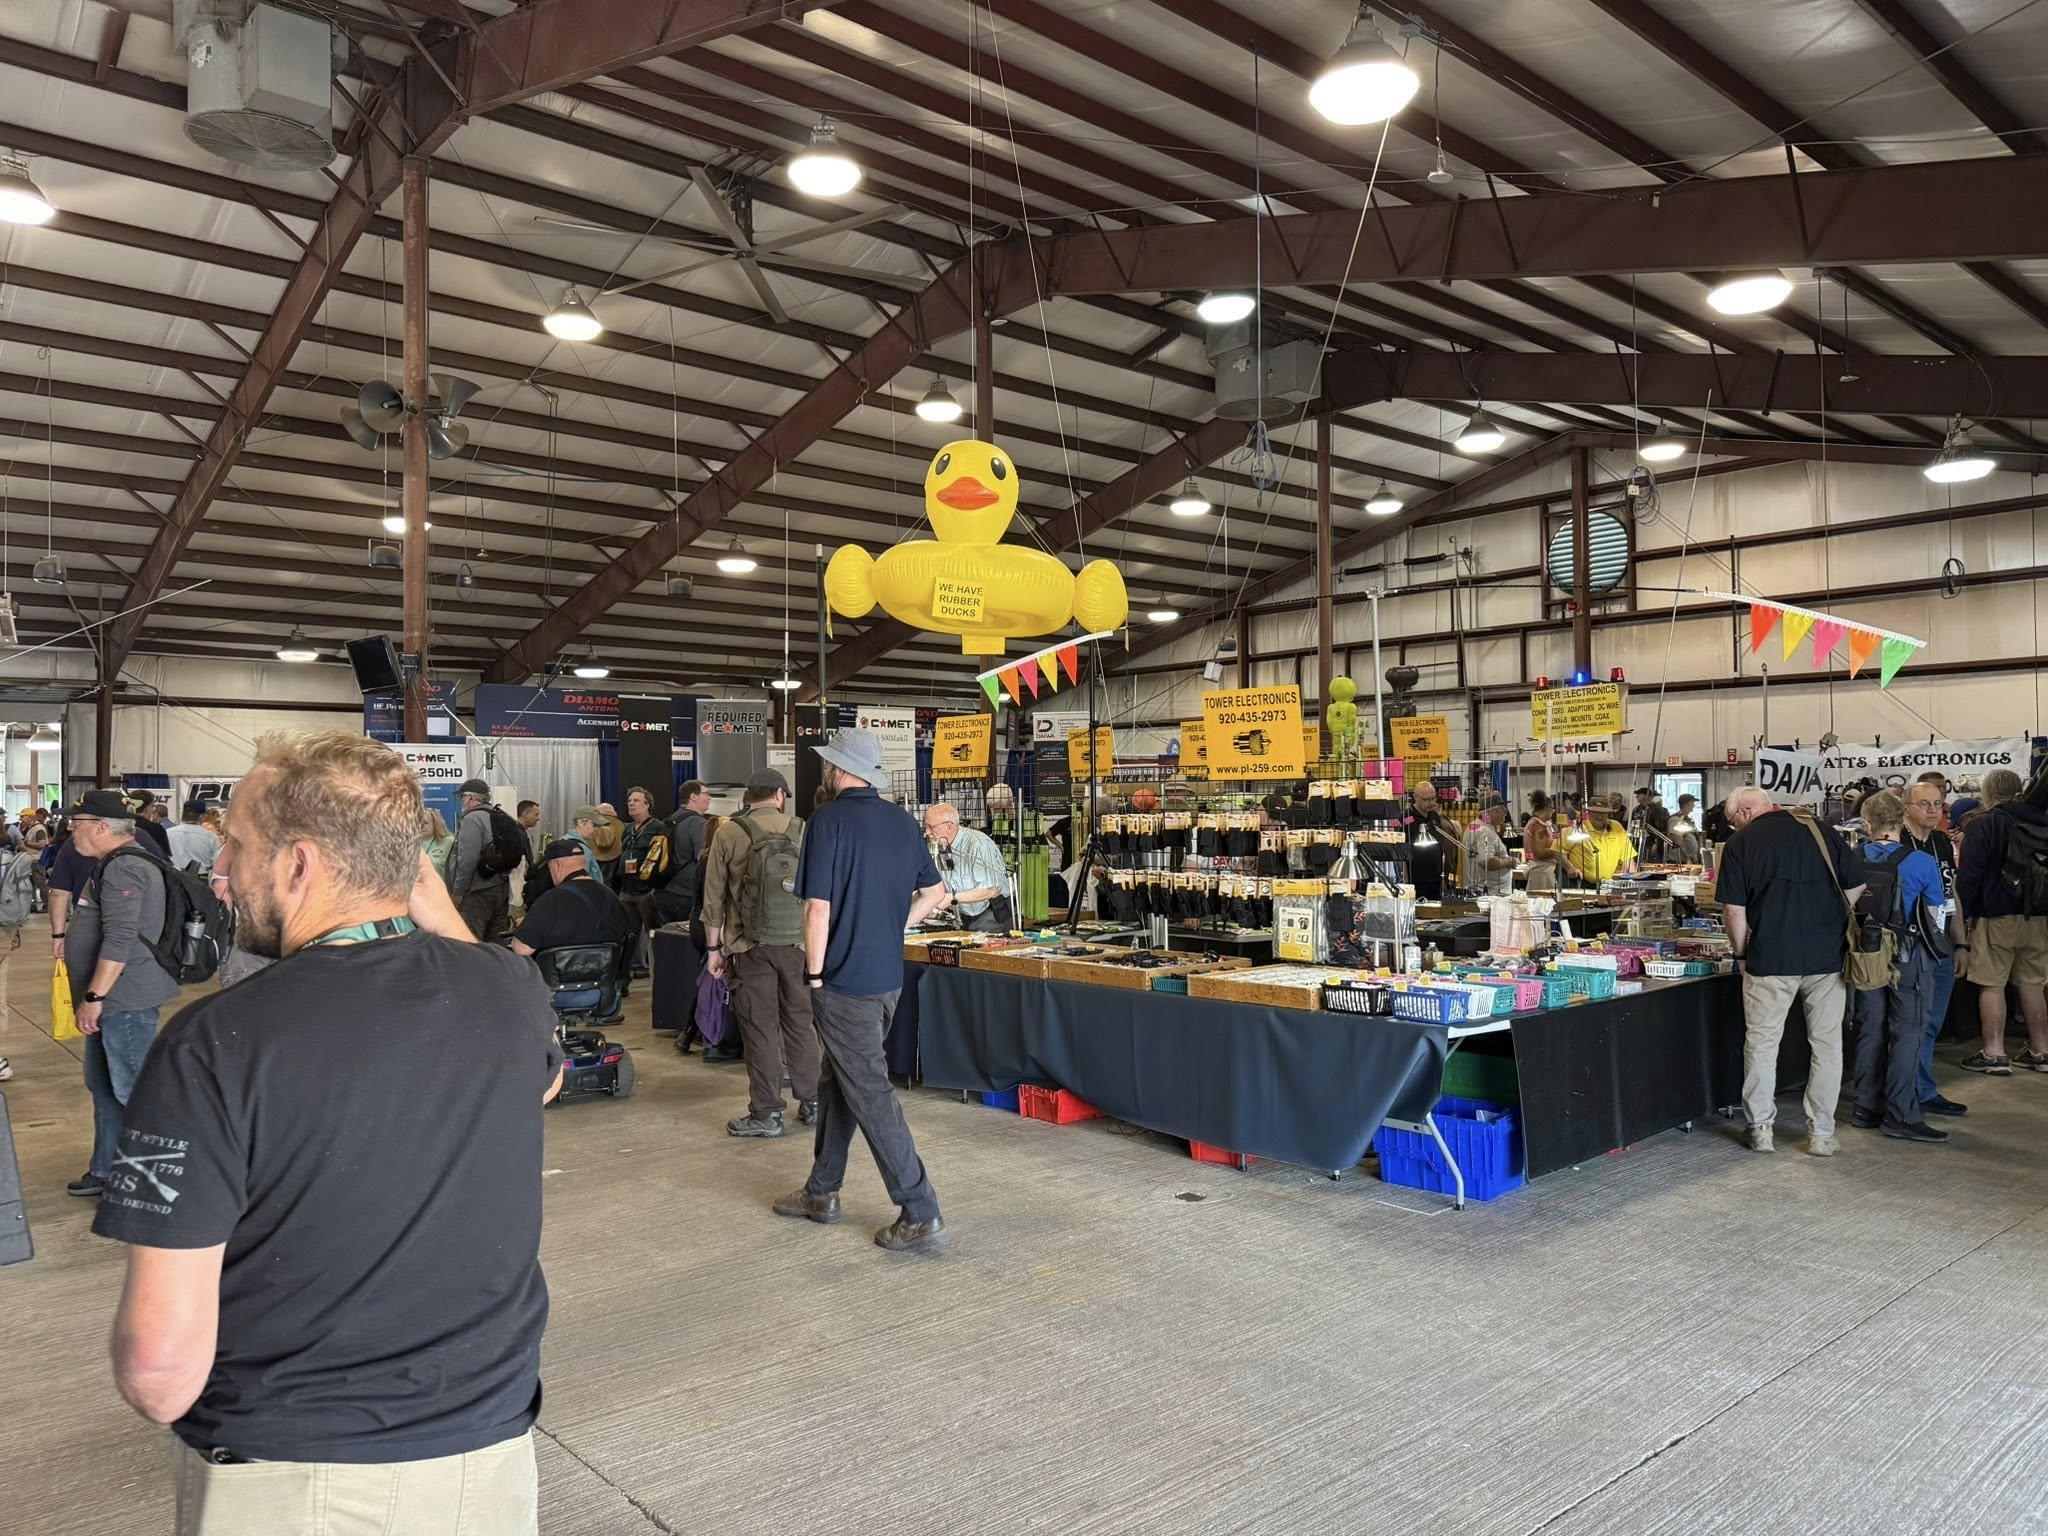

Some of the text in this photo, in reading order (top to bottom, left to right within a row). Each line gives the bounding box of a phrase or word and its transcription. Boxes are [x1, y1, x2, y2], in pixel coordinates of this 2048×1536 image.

[939, 583, 984, 596] WE HAVE
[939, 594, 980, 606] RUBBER
[941, 606, 976, 617] DUCKS
[1534, 691, 1561, 701] TOWER
[1563, 685, 1616, 699] ELECTRONICS
[1205, 691, 1297, 709] TOWER ELECTRONICS
[707, 712, 765, 722] REQUIRED!
[1219, 710, 1287, 724] 920-435-2973
[1571, 714, 1592, 723] MOUNTS
[1595, 713, 1610, 721] COAX
[937, 718, 990, 730] TOWER ELECTRONICS
[1877, 752, 2012, 768] ELECTRONICS
[1217, 763, 1294, 775] www.pl-259.com
[140, 1134, 190, 1151] STYLE
[151, 1161, 184, 1177] 1776
